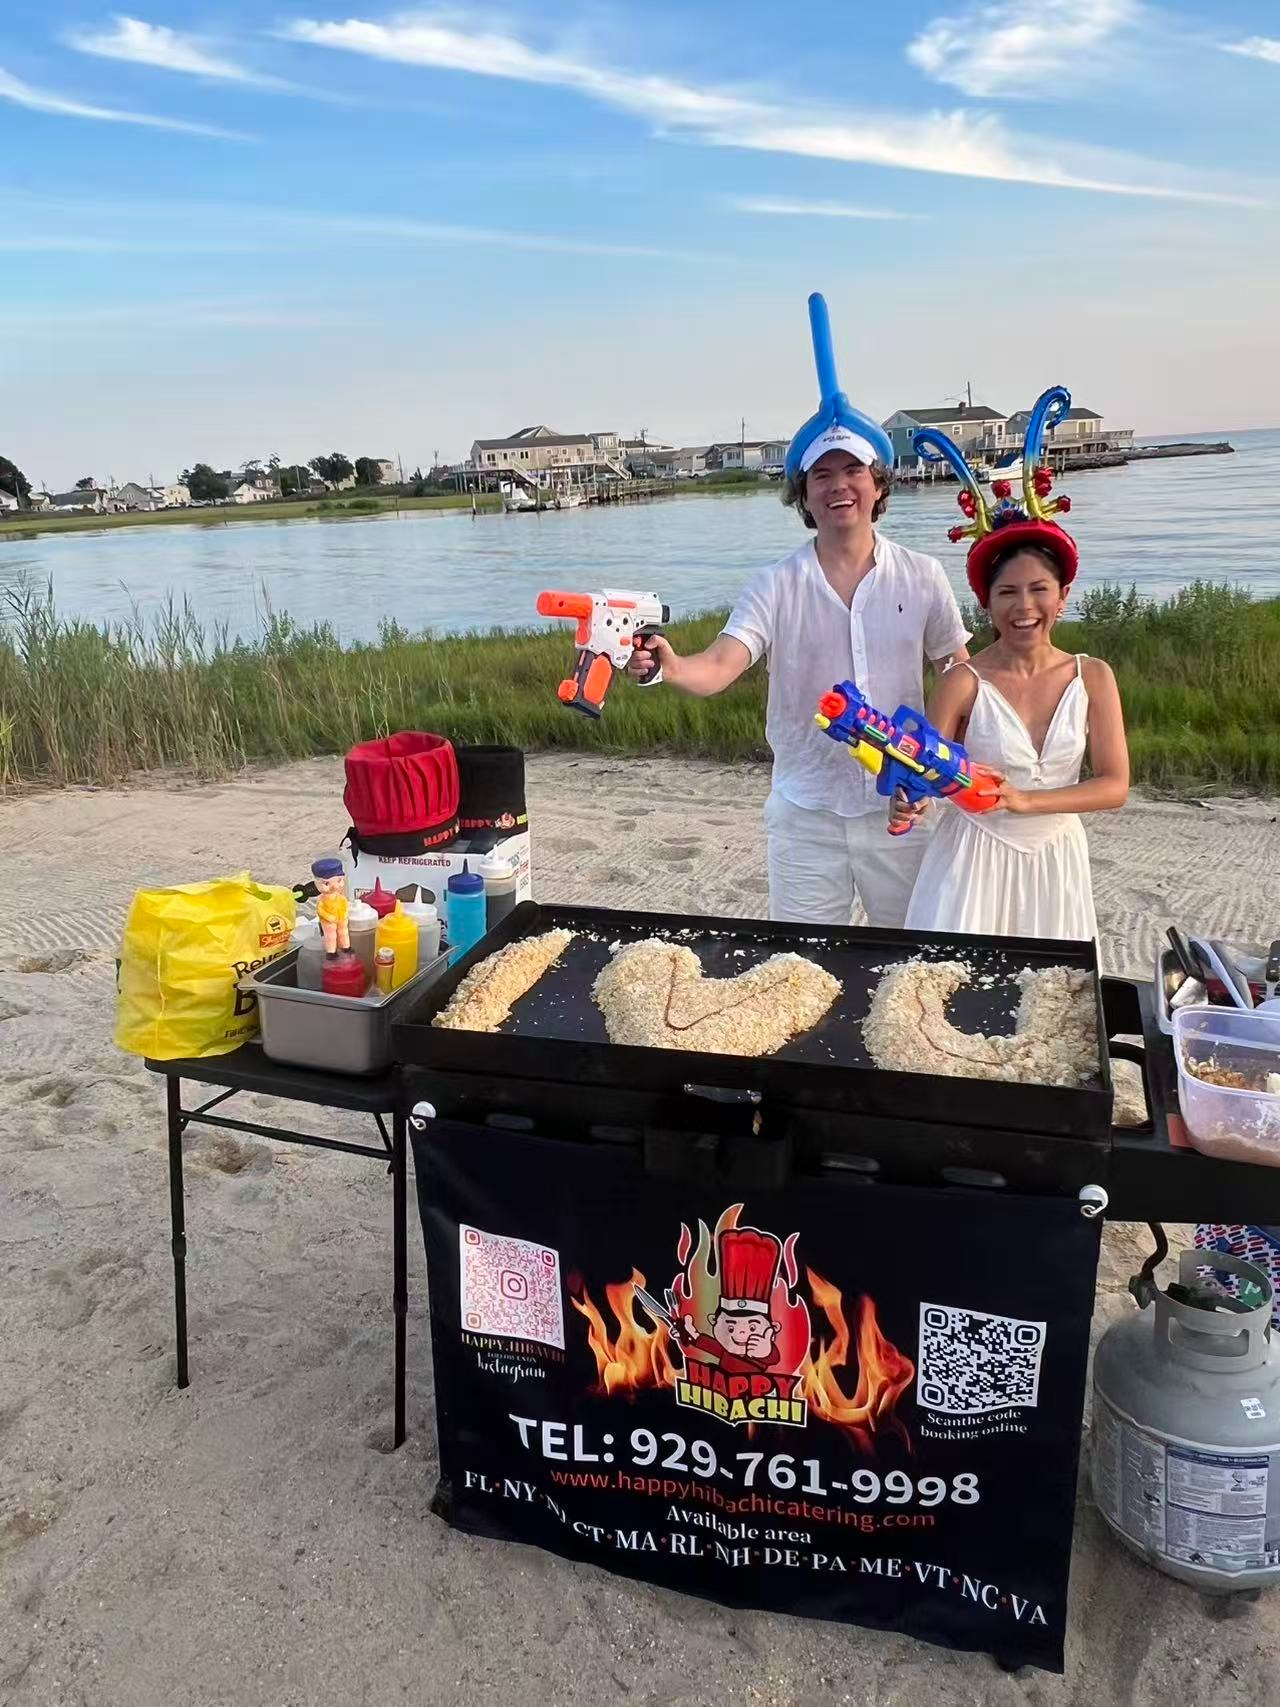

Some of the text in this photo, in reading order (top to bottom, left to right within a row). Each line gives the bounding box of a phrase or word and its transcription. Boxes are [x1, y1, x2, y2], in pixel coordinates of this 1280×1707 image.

[424, 828, 454, 846] HAPPY
[378, 856, 451, 867] KEEP REFRIGERATED
[477, 1352, 546, 1384] Instagram
[688, 1361, 795, 1399] HAPPY
[680, 1382, 802, 1421] HIBACHI
[987, 1409, 1022, 1422] code
[921, 1423, 1028, 1440] booking online
[509, 1413, 980, 1507] TEL: 929-761-9998
[551, 1470, 935, 1532] www.happyhibachicatering.com
[667, 1505, 812, 1544] Available area
